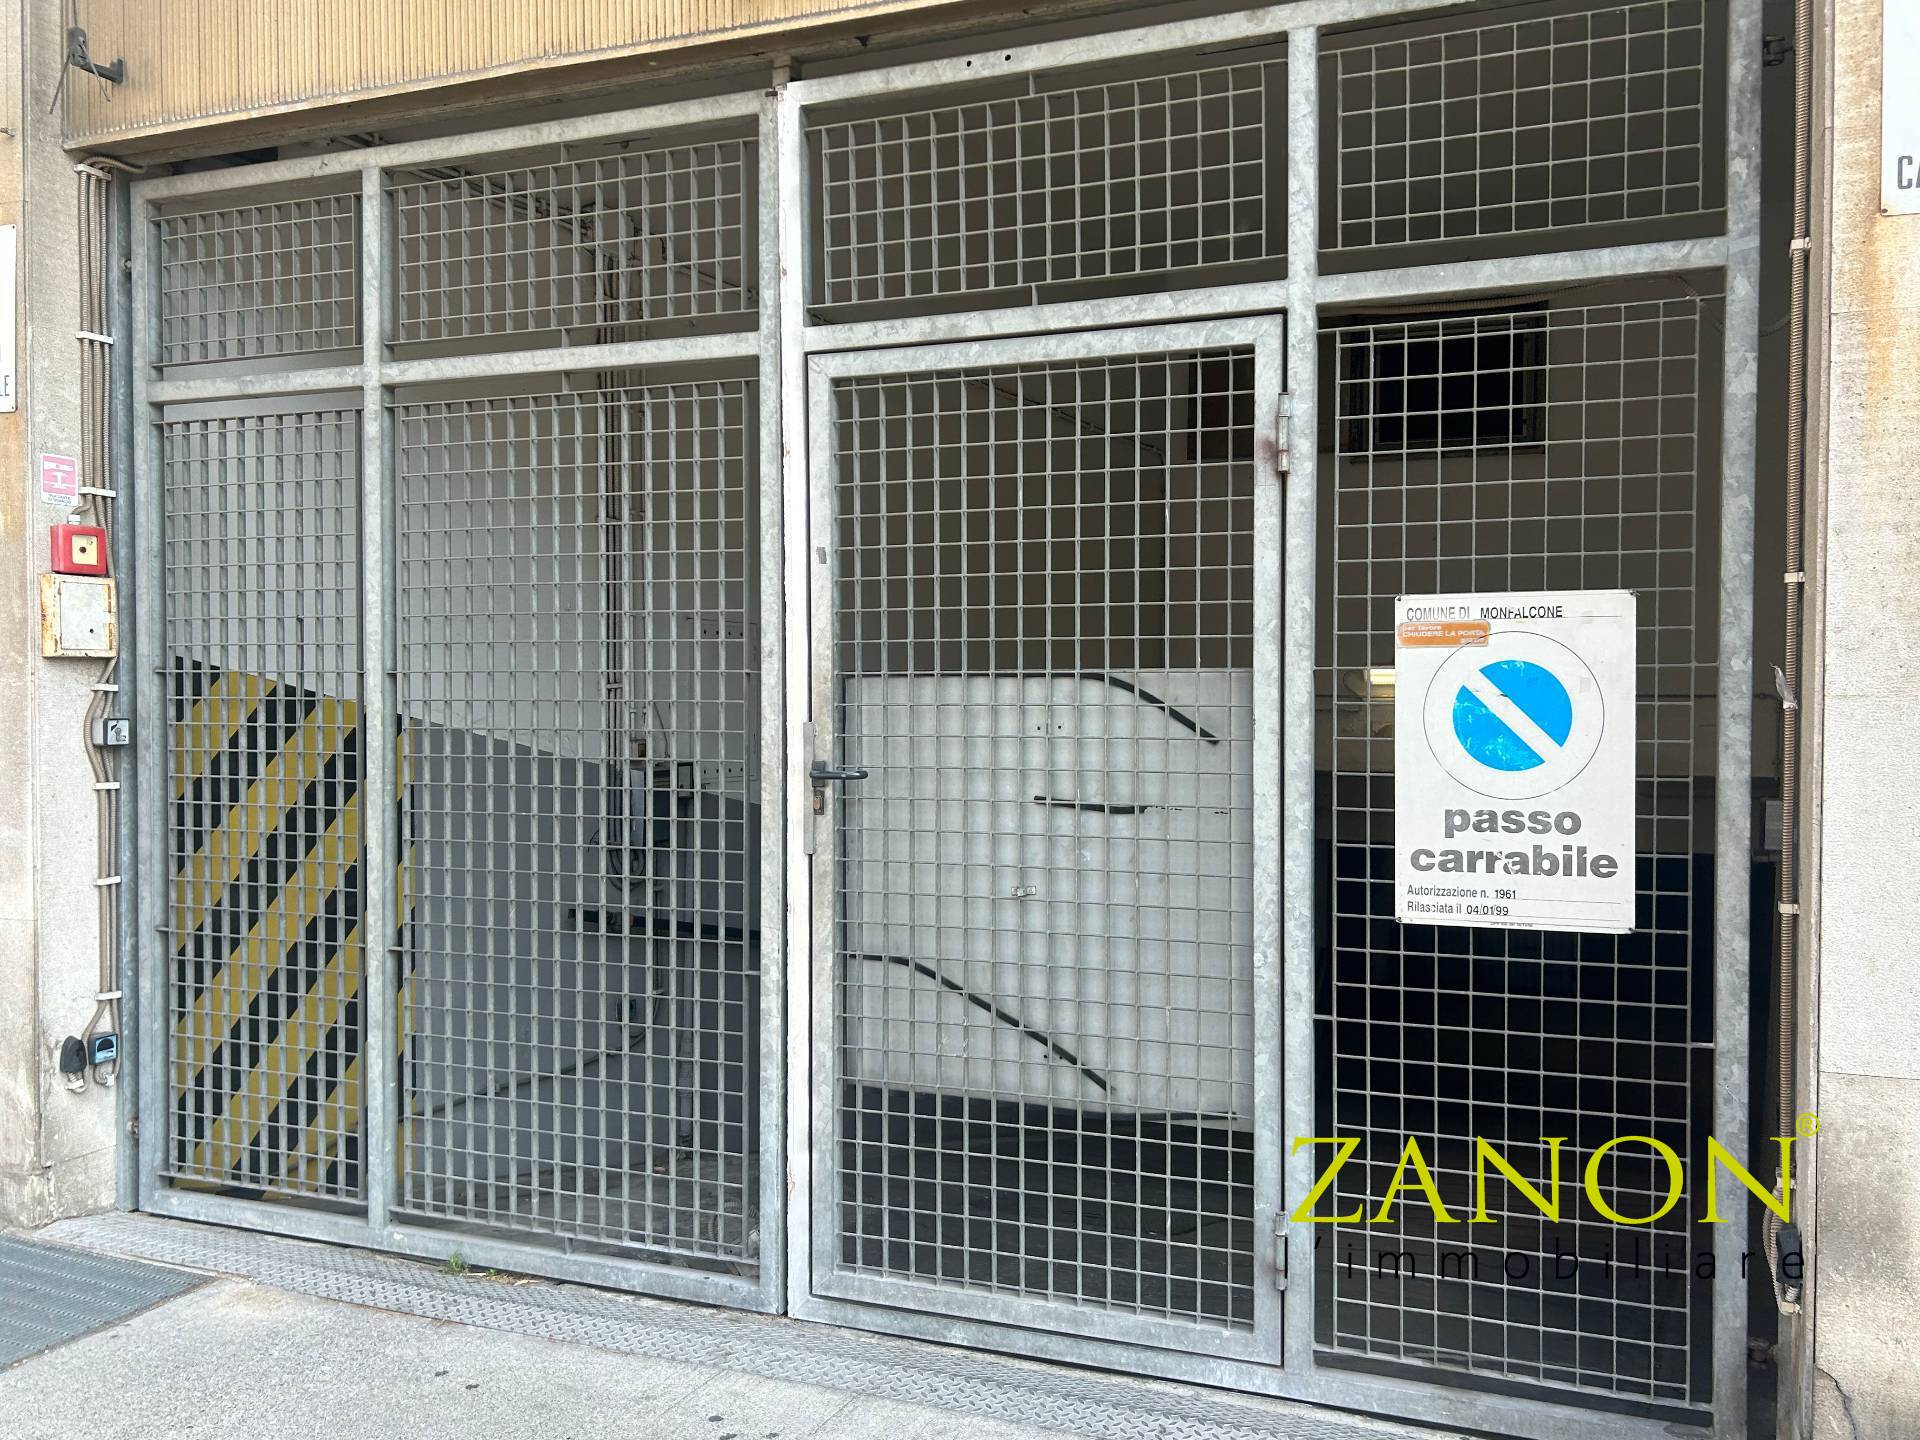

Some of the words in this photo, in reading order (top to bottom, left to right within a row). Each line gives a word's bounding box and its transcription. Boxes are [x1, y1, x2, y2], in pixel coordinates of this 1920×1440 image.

[1406, 607, 1455, 621] COMUNE
[1458, 606, 1470, 619] DI
[1480, 605, 1563, 620] MONFALCONE
[1444, 808, 1582, 839] passo
[1409, 844, 1619, 879] carrabile
[1407, 884, 1478, 898] Autorizzazione
[1480, 889, 1490, 899] n.
[1494, 888, 1517, 900] 1961
[1407, 900, 1454, 914] Rilasciata
[1456, 903, 1462, 914] il
